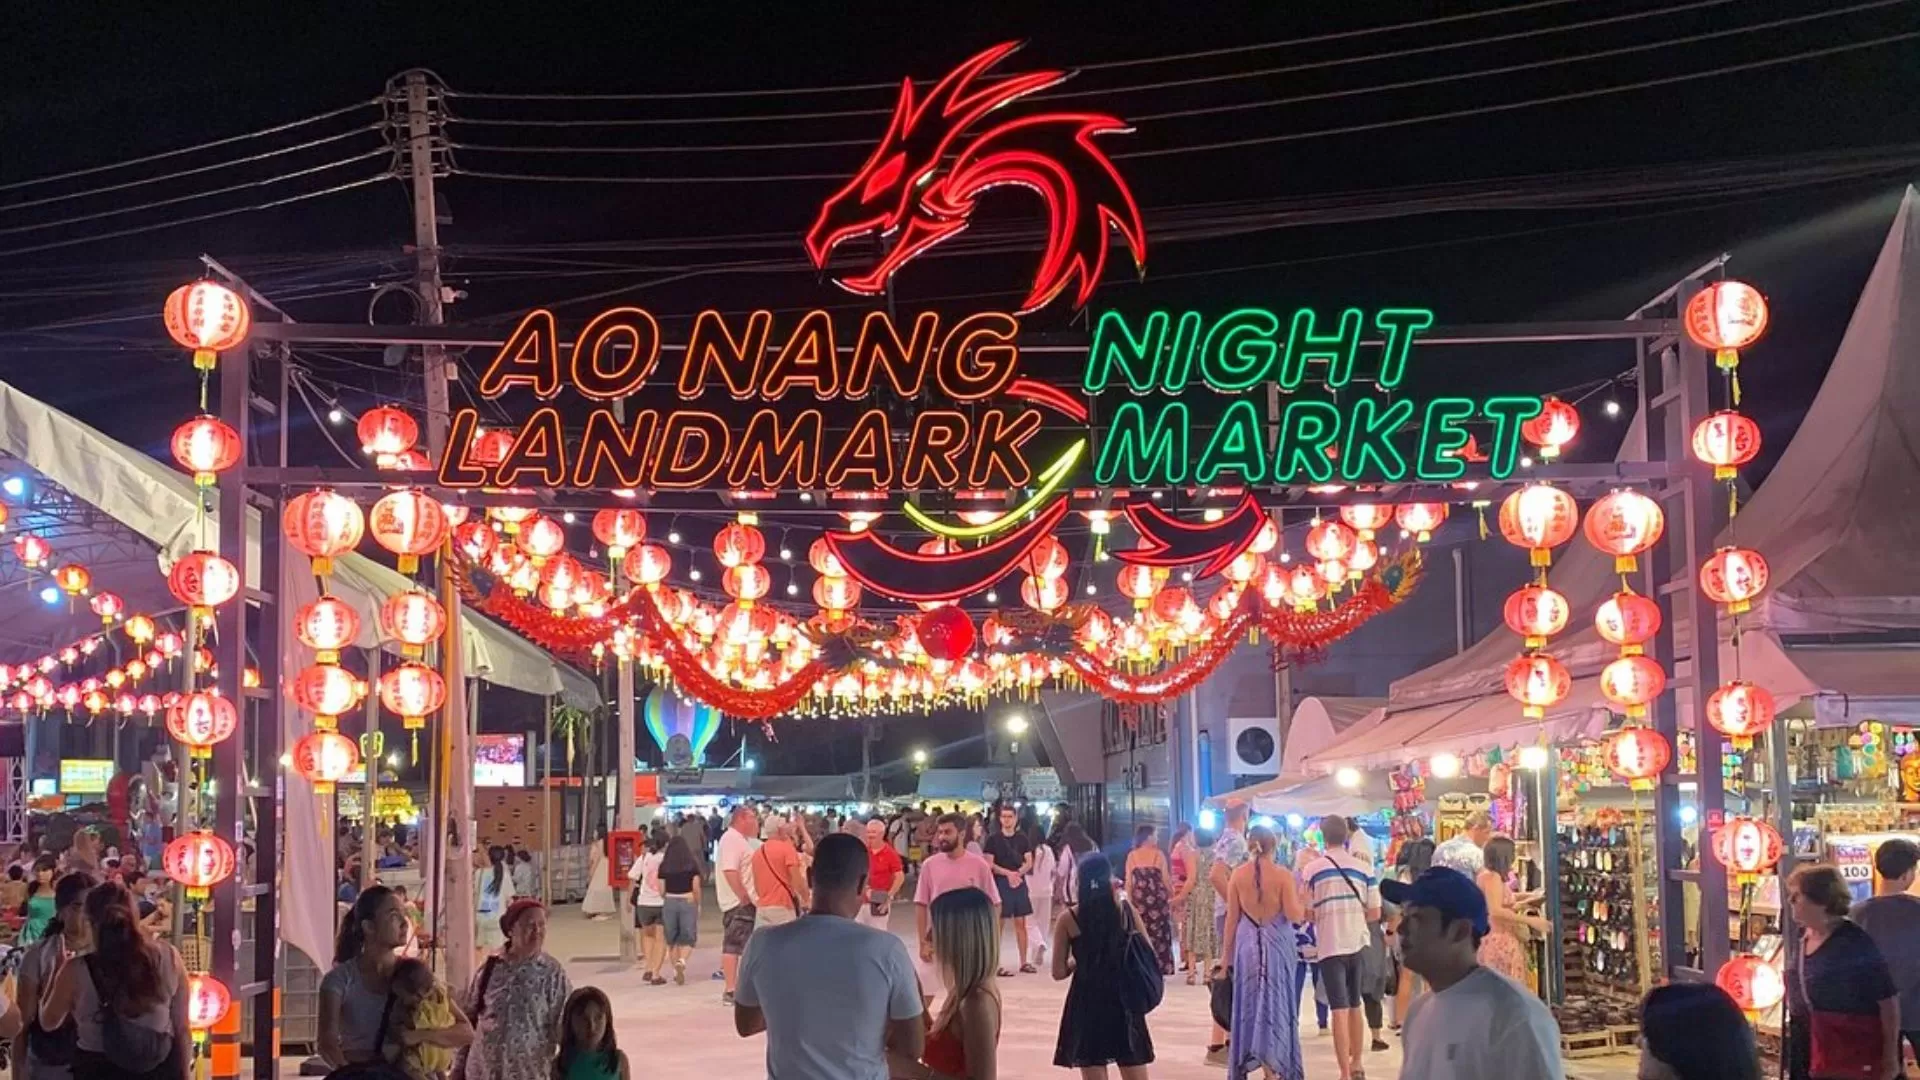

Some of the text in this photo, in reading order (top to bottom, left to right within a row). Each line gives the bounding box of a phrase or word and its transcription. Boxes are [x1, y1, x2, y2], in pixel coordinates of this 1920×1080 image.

[479, 306, 1020, 399] AO NANG
[1082, 307, 1434, 393] NIGHT
[437, 407, 1043, 489] LANDMARK
[1094, 396, 1544, 484] MARKET
[1843, 866, 1869, 878] 100
